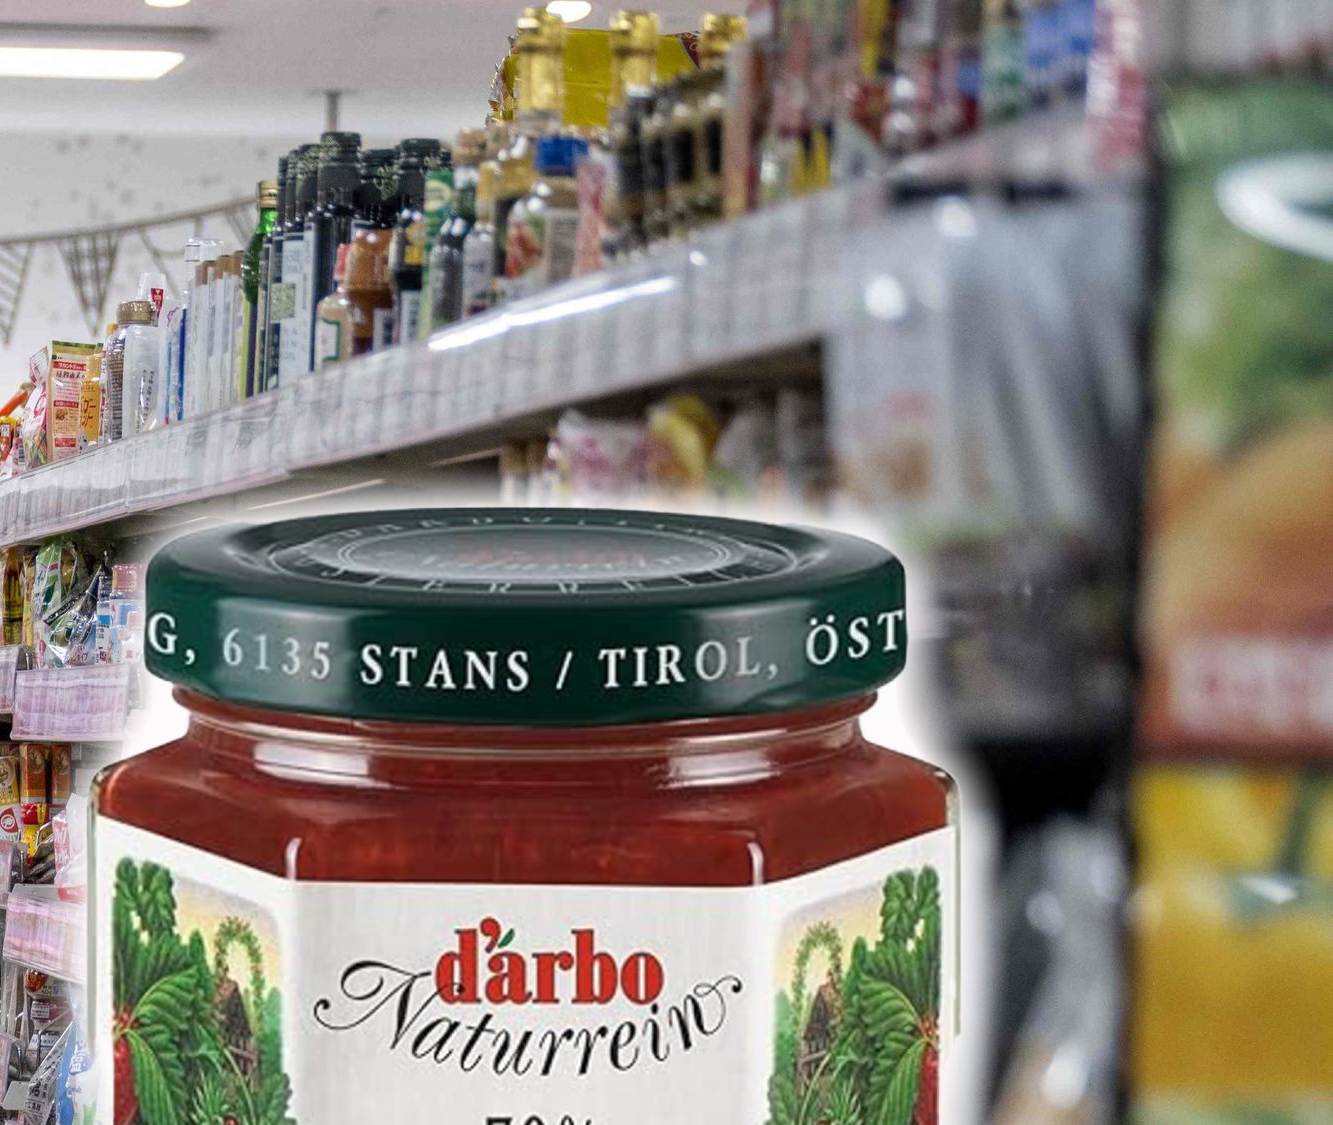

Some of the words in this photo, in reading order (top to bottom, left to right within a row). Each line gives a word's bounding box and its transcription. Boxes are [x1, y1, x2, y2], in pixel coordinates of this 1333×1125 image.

[222, 627, 334, 678] 6135
[358, 643, 531, 693] STANS
[552, 651, 575, 692] /
[595, 636, 781, 690] TIROL,
[313, 960, 744, 1078] Naturrein
